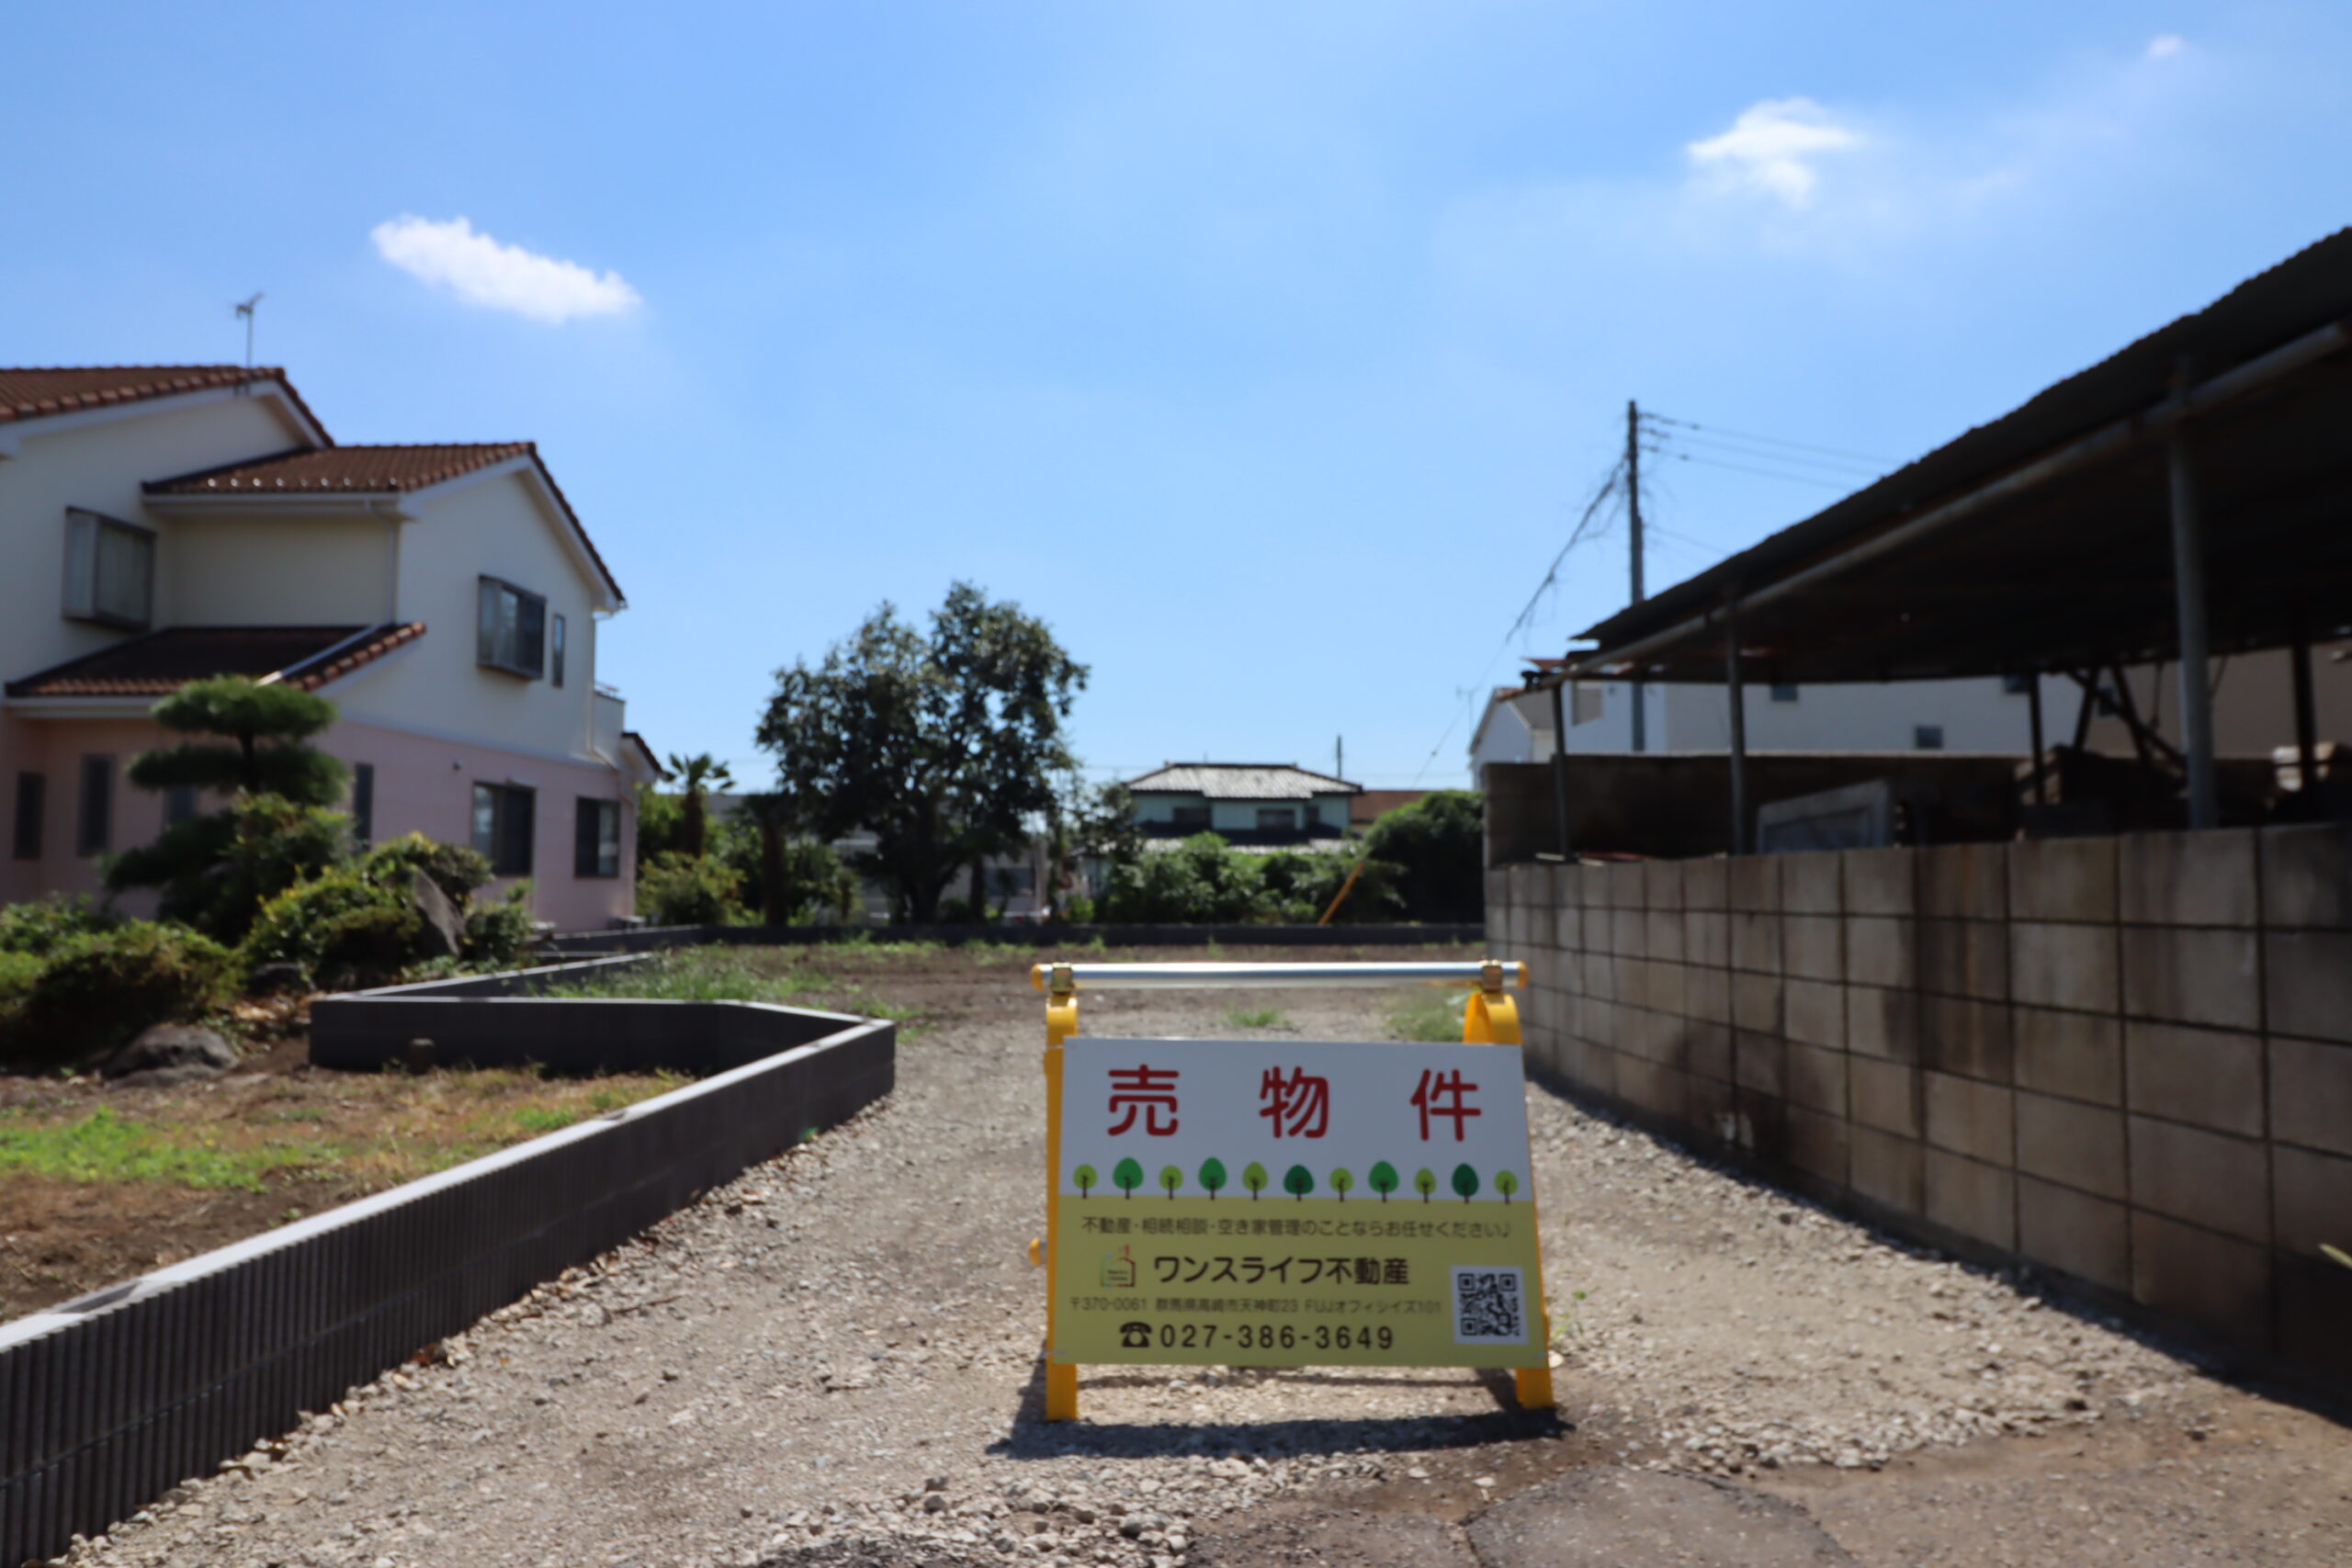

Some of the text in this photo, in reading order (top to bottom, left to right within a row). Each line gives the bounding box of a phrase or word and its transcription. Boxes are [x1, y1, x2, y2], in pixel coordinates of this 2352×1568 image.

[1107, 1064, 1482, 1142] 売物件
[1154, 1256, 1410, 1286] ワンスライフ不動産
[1159, 1324, 1394, 1350] 027-386-3649
